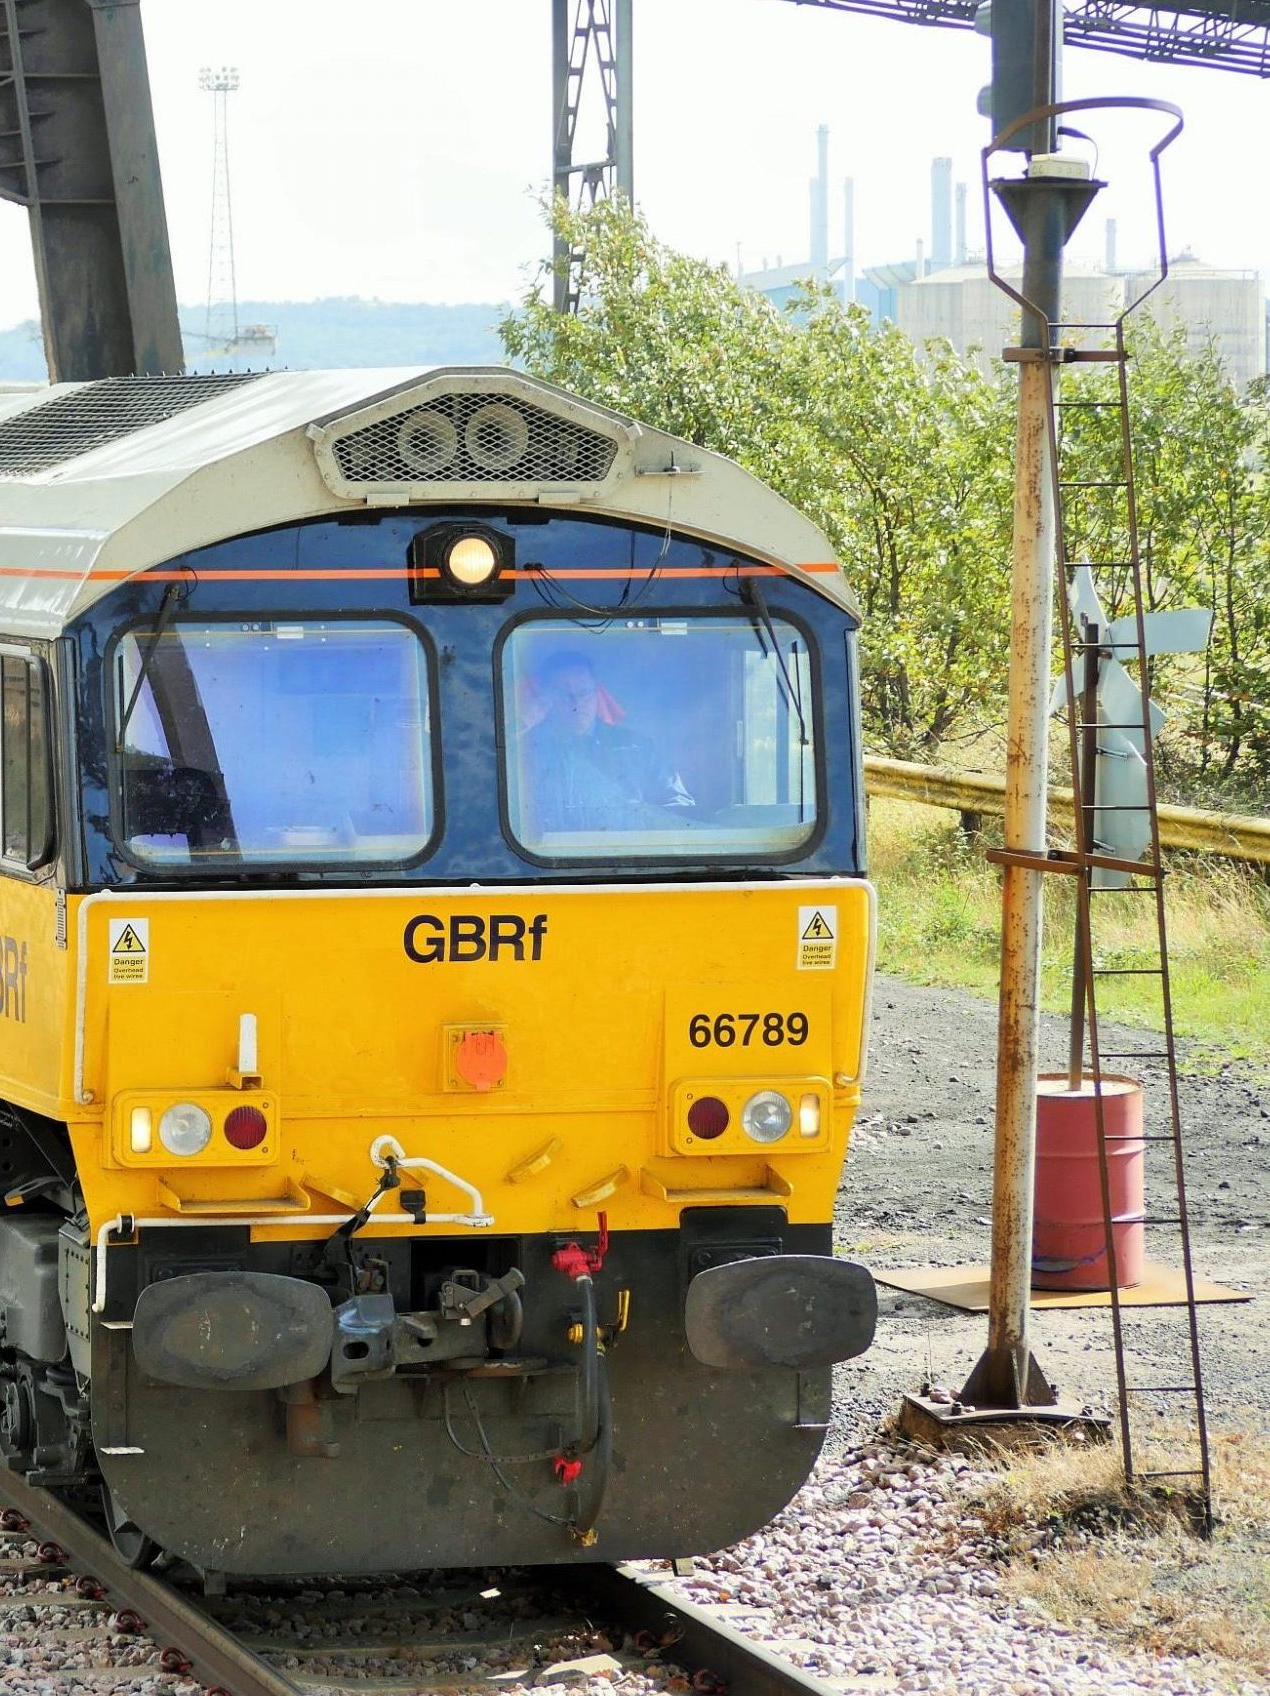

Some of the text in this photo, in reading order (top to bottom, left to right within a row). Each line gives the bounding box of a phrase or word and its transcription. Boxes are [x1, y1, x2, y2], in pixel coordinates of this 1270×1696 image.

[403, 914, 548, 963] GBRf
[114, 958, 144, 966] Danger
[689, 1012, 809, 1048] 66789
